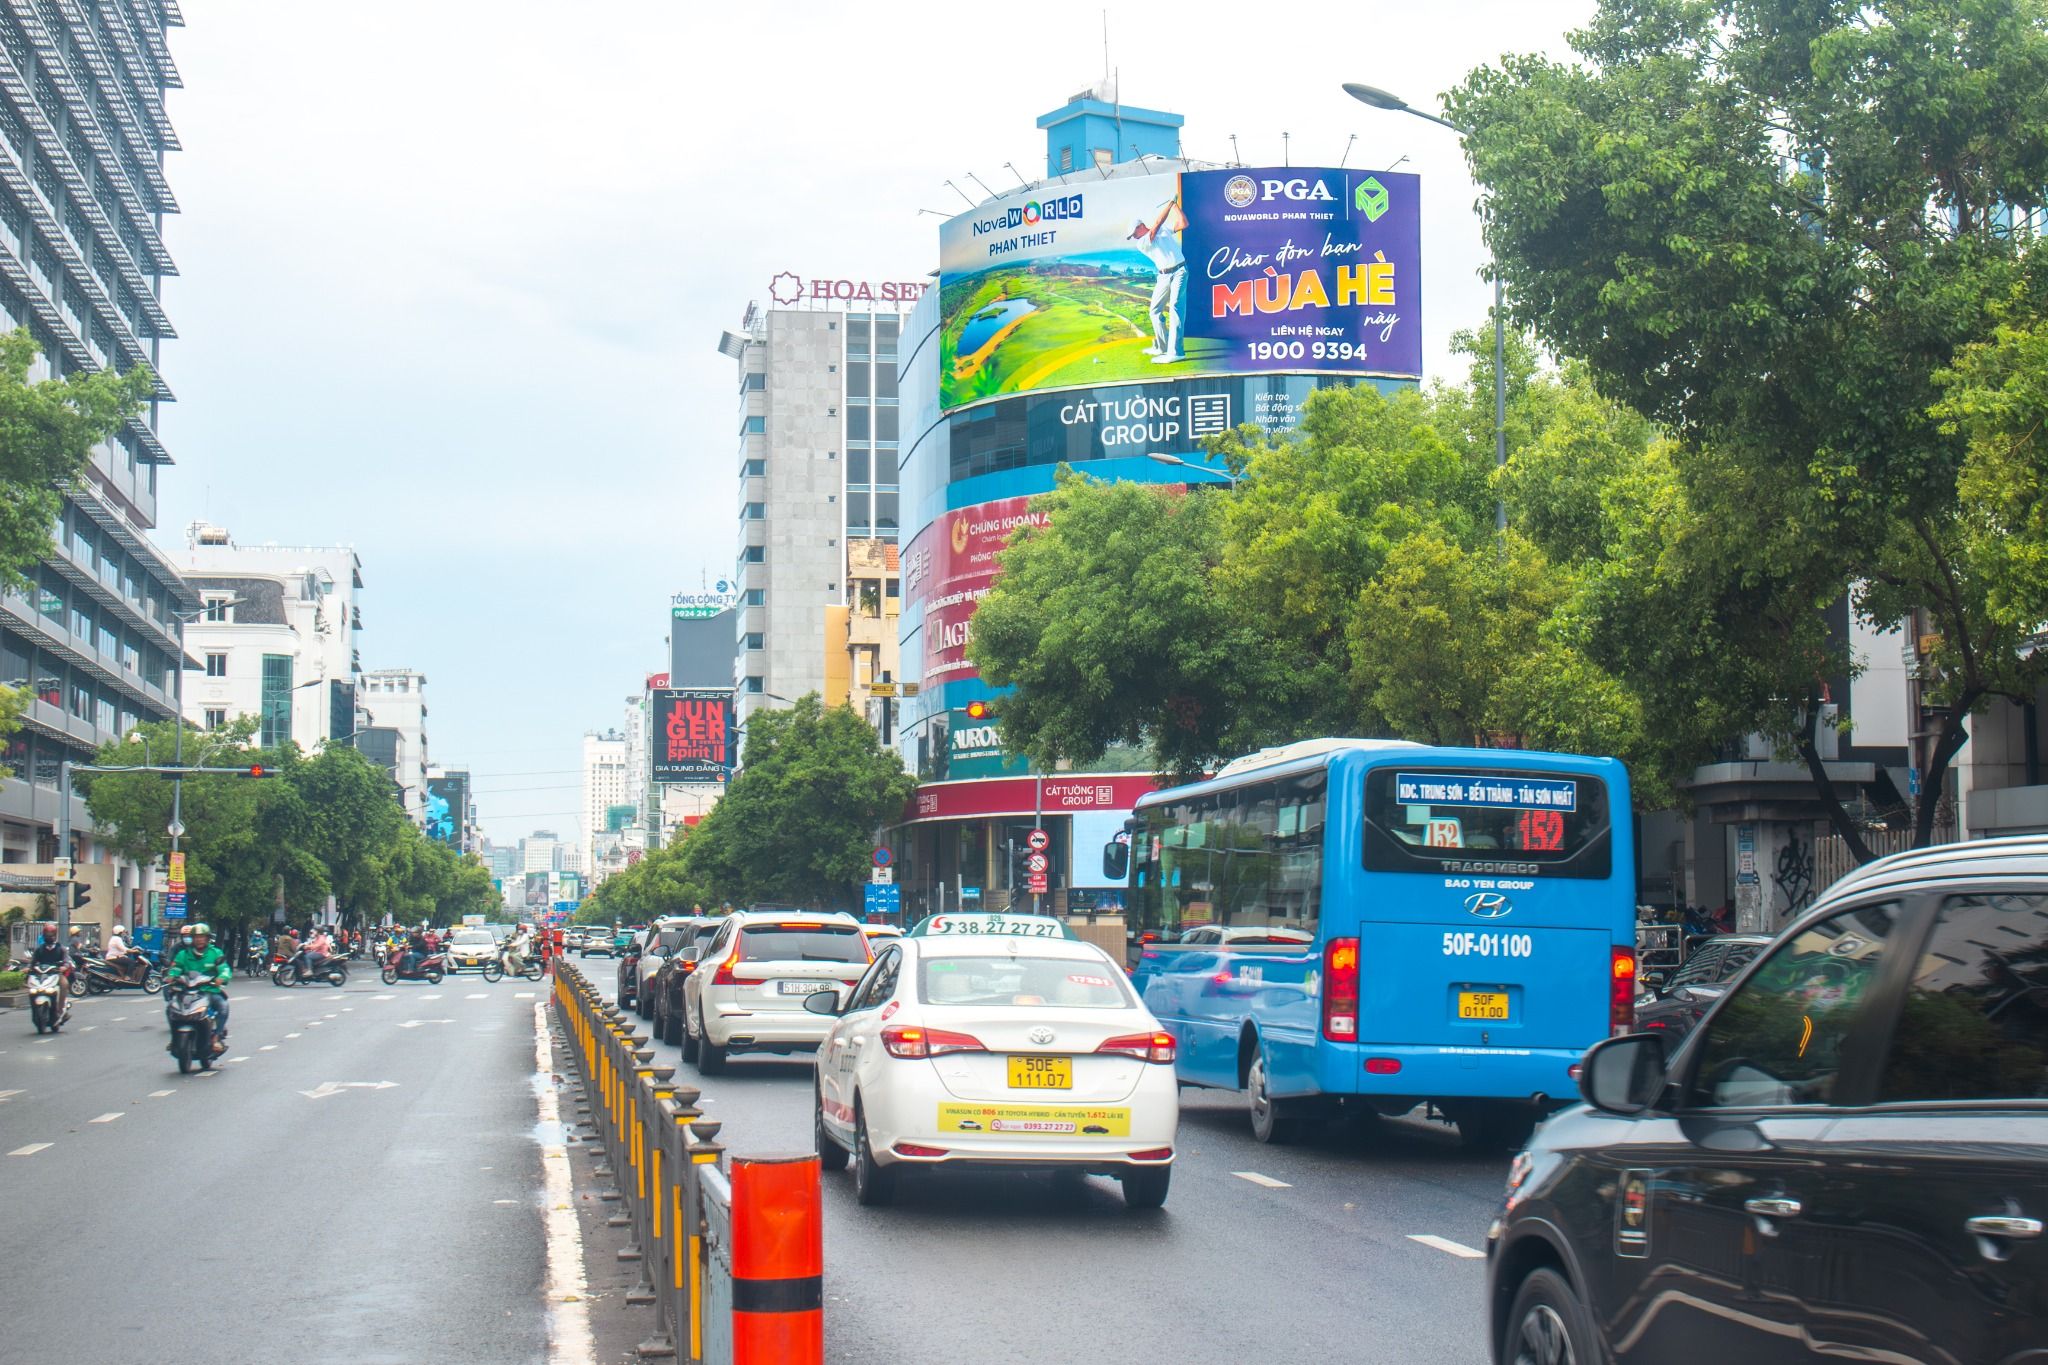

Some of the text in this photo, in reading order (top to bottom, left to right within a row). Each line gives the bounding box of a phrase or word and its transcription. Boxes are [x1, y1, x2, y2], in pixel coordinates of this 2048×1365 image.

[1261, 179, 1334, 201] PGA
[1224, 212, 1334, 222] NOVAWORLD PHAN THIET
[989, 231, 1057, 256] PHAN THIET
[1207, 232, 1363, 279] Chào đón bạn
[811, 280, 875, 300] HOA
[1212, 250, 1396, 318] MÙA HÈ
[1271, 324, 1344, 338] LIÊN HỆ NGAY
[1364, 311, 1400, 343] này
[1248, 342, 1367, 361] 1900 9394
[1275, 393, 1290, 402] tạo
[1060, 394, 1181, 425] CÁT TƯỜNG
[1271, 402, 1294, 414] động
[1255, 414, 1278, 423] Nhân
[1101, 422, 1180, 446] GROUP
[671, 591, 736, 604] TỔNG CÔNG TY
[665, 690, 733, 698] JUNGER
[667, 701, 724, 720] JUN
[666, 719, 725, 740] GER
[952, 726, 1003, 750] AUROR
[670, 745, 710, 761] spirit
[1046, 785, 1094, 796] CÁT TƯỜNG
[1400, 783, 1418, 799] KDC.
[1419, 784, 1446, 800] TRUNG
[1447, 783, 1463, 801] SƠN
[1469, 780, 1486, 802] BẾN
[1486, 783, 1512, 803] THÀNH
[1518, 784, 1534, 804] TÂN
[1535, 788, 1551, 804] SƠN
[1552, 785, 1573, 806] NHẤT
[1062, 796, 1094, 805] GROUP
[1428, 822, 1458, 848] 152
[1519, 810, 1564, 850] 152
[1441, 860, 1539, 874] TRACOMECO
[1444, 879, 1535, 890] BAO YEN GROUP
[958, 921, 1056, 936] 38.27 27 27
[1442, 932, 1532, 958] 50F-01100
[1473, 994, 1494, 1005] 50F
[1464, 1006, 1503, 1017] 011.00
[1026, 1058, 1053, 1072] 50E
[1017, 1073, 1065, 1086] 111.07
